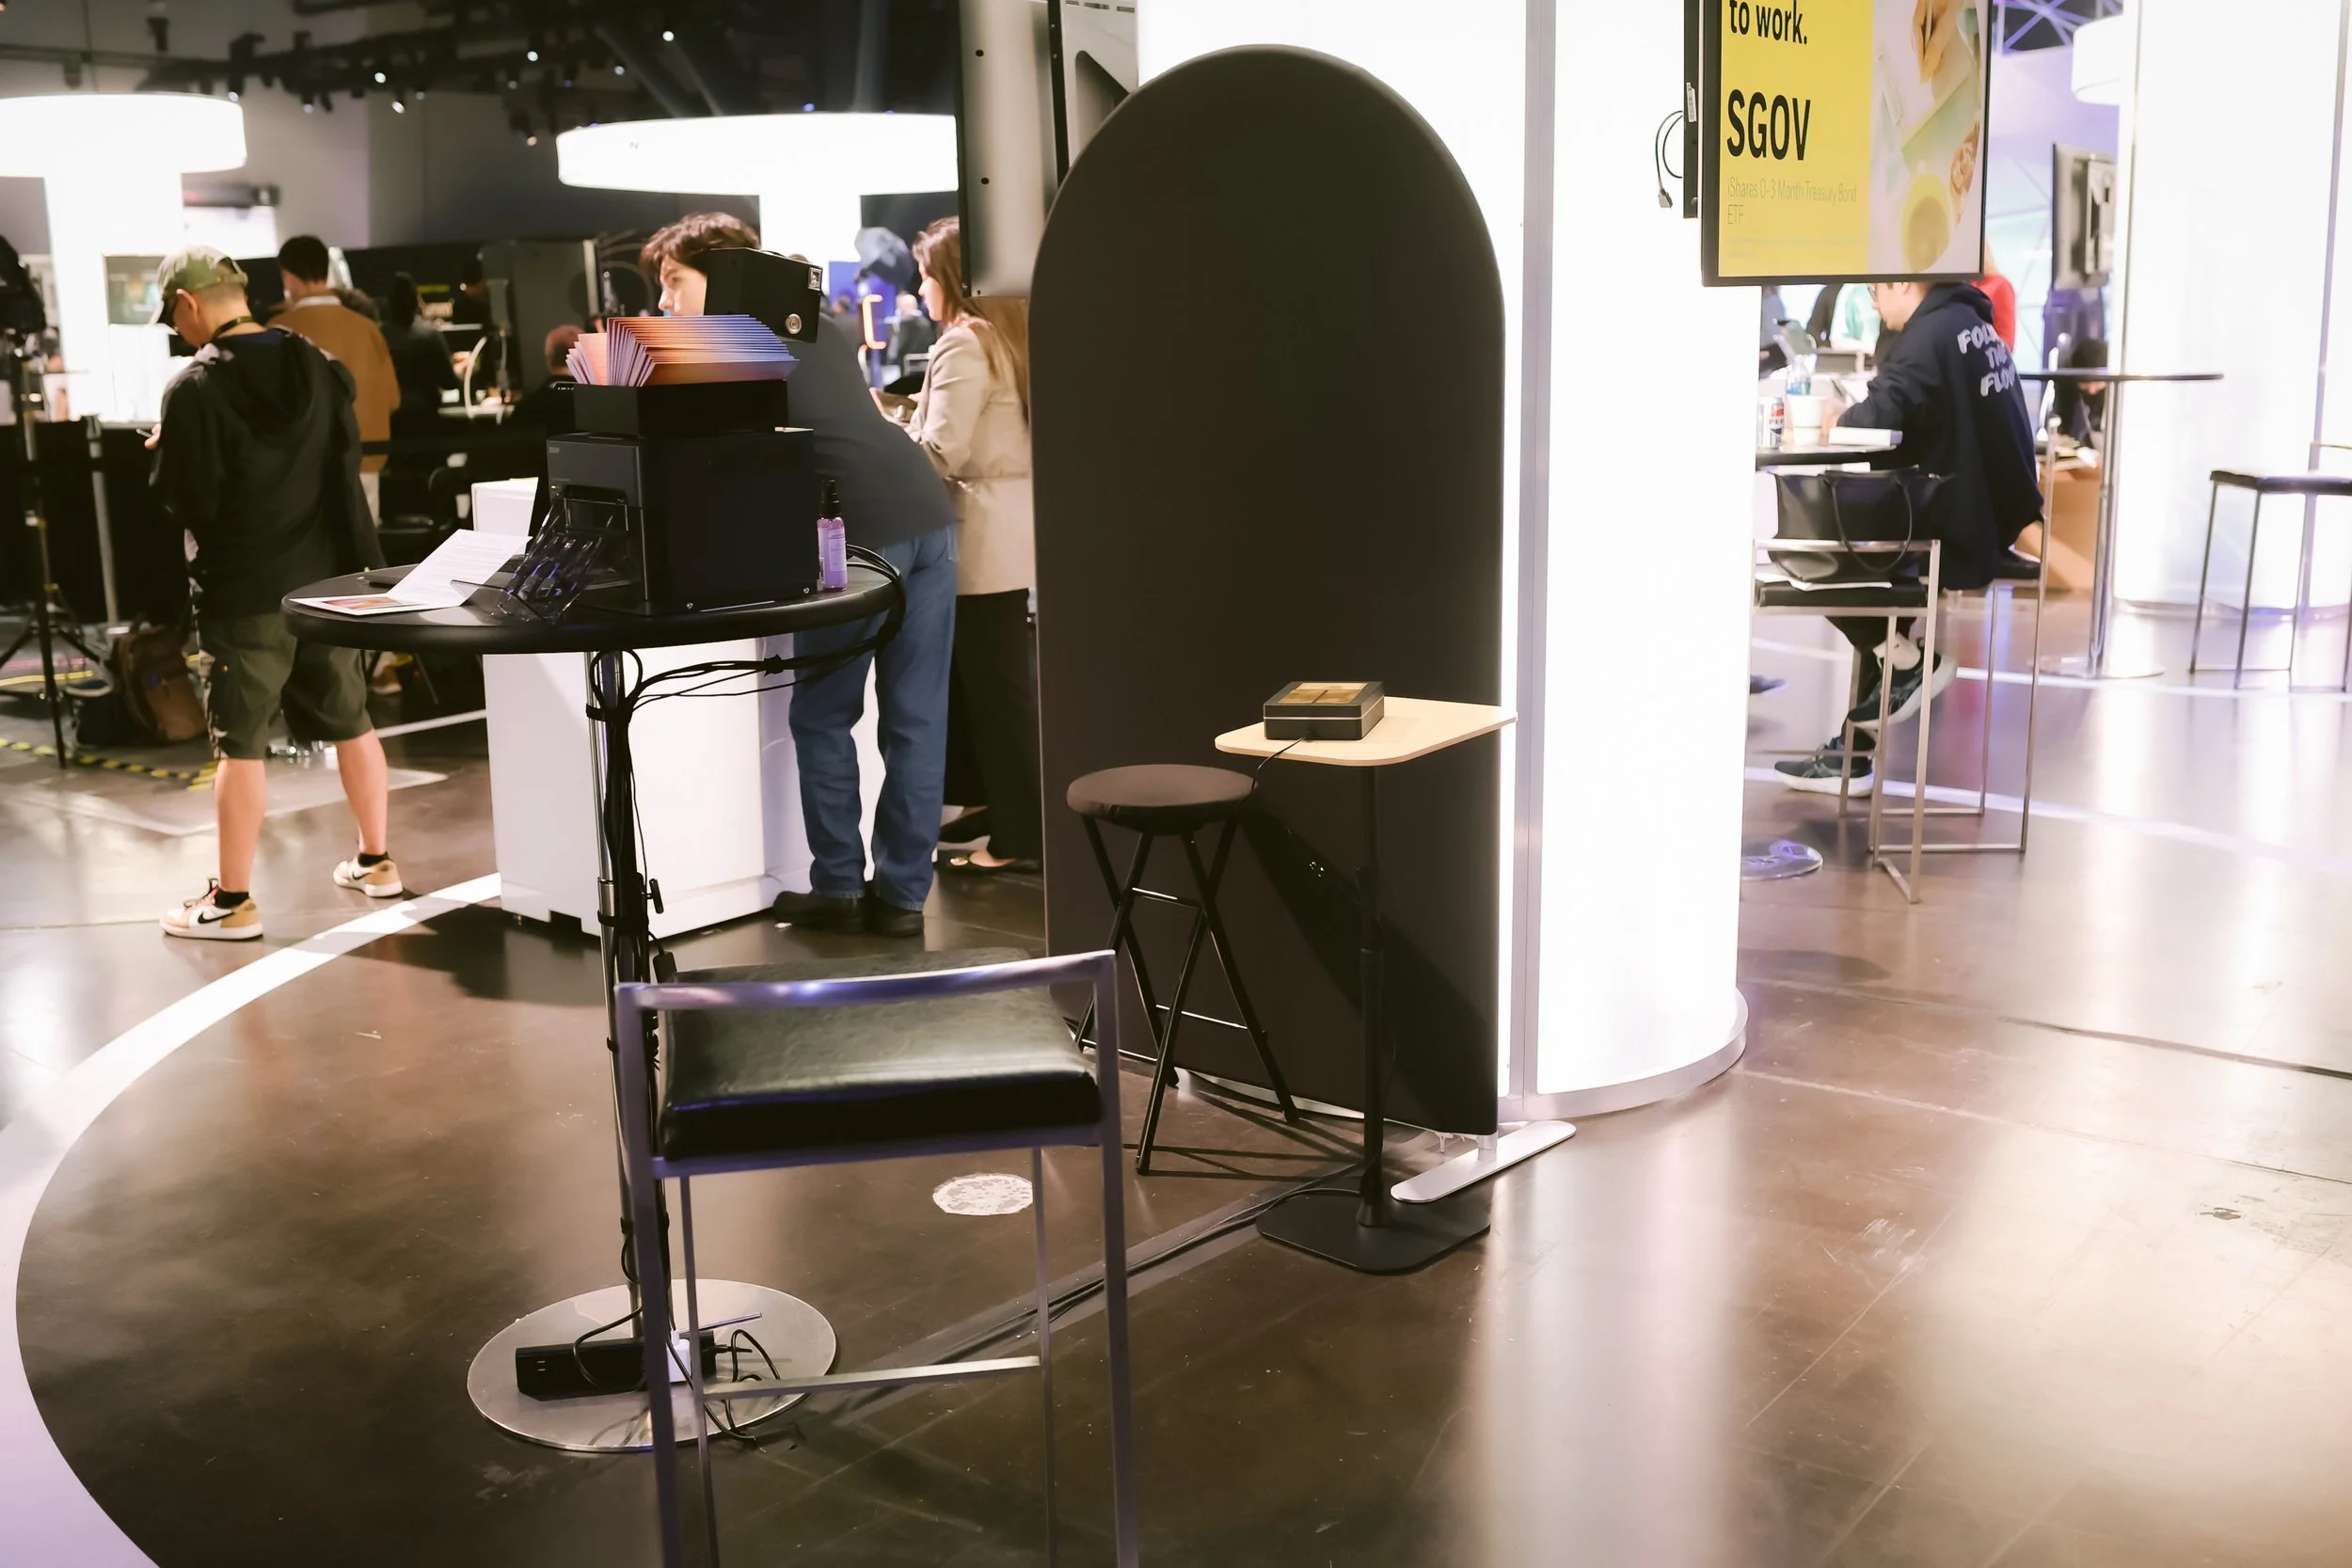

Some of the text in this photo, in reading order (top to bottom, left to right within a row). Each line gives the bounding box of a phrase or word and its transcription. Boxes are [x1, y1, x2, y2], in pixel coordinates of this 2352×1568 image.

[1729, 0, 1807, 45] to work.
[1726, 88, 1811, 161] SGOV
[1727, 177, 1858, 206] iShares 0-3 Month Treasury Bond
[1727, 204, 1745, 225] ETF
[1957, 324, 1999, 354] FOLL
